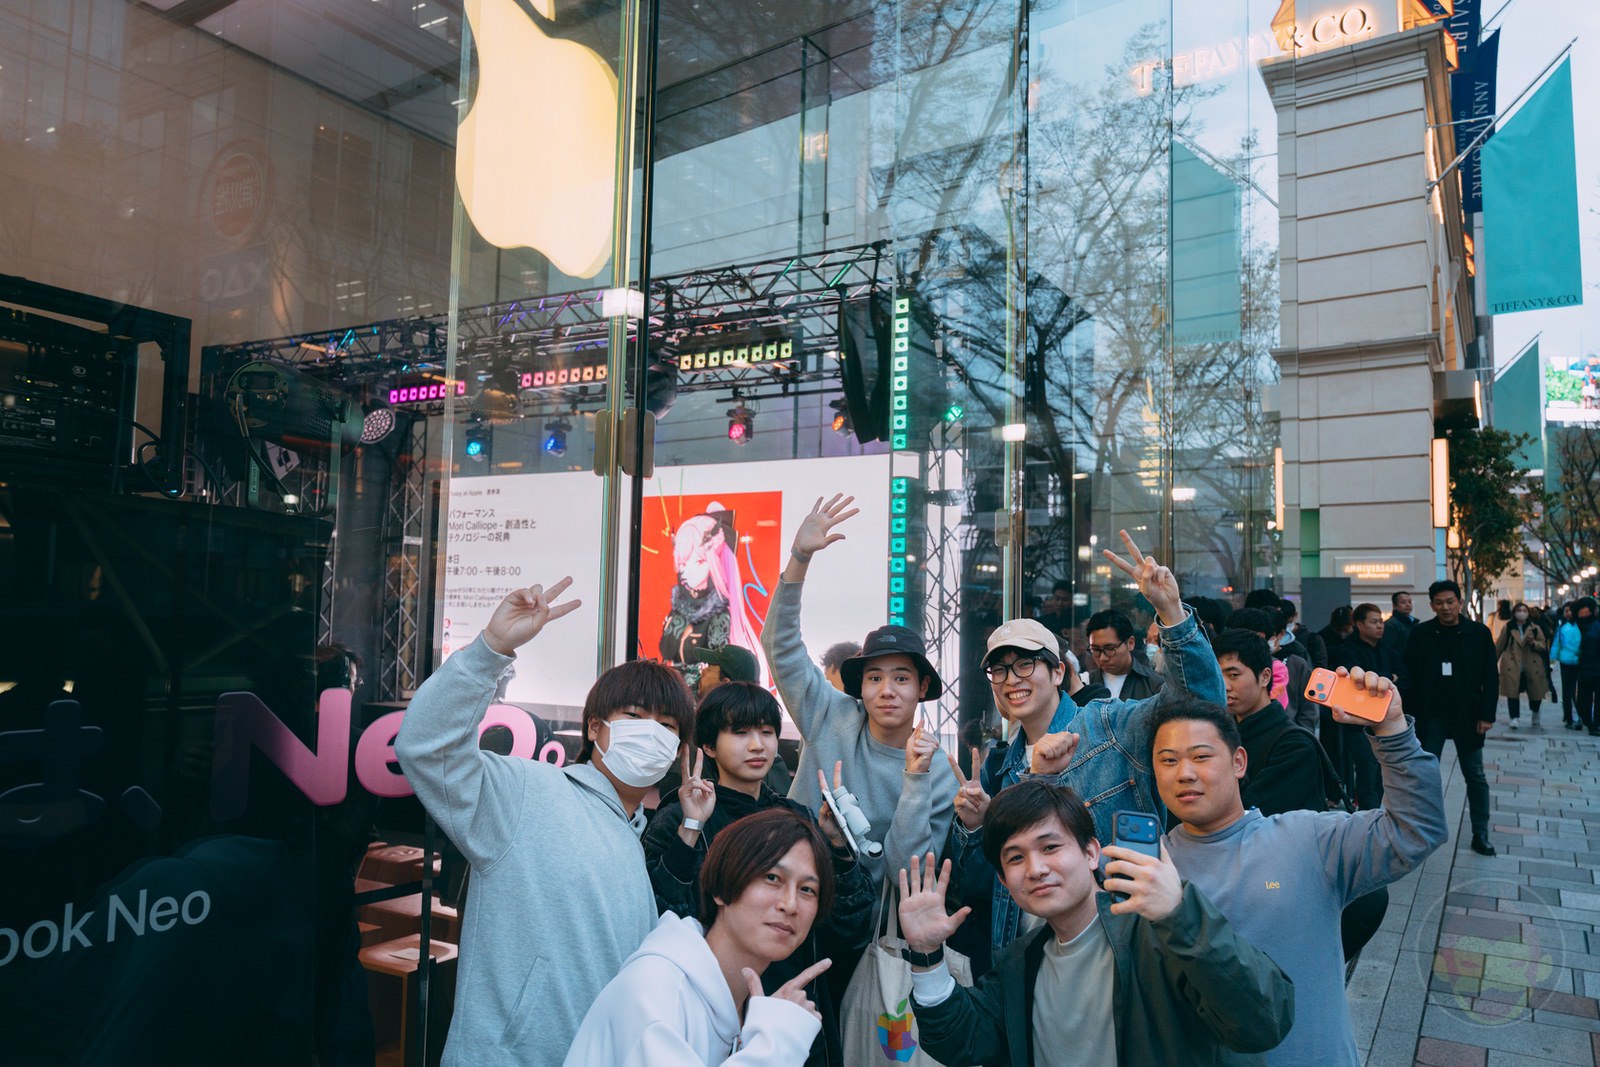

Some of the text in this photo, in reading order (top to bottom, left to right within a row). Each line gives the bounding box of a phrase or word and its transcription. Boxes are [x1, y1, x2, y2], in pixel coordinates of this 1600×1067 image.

[465, 520, 498, 532] Calliope
[505, 518, 537, 530] 創造性と
[447, 554, 460, 565] 本日
[107, 888, 211, 944] Neo
